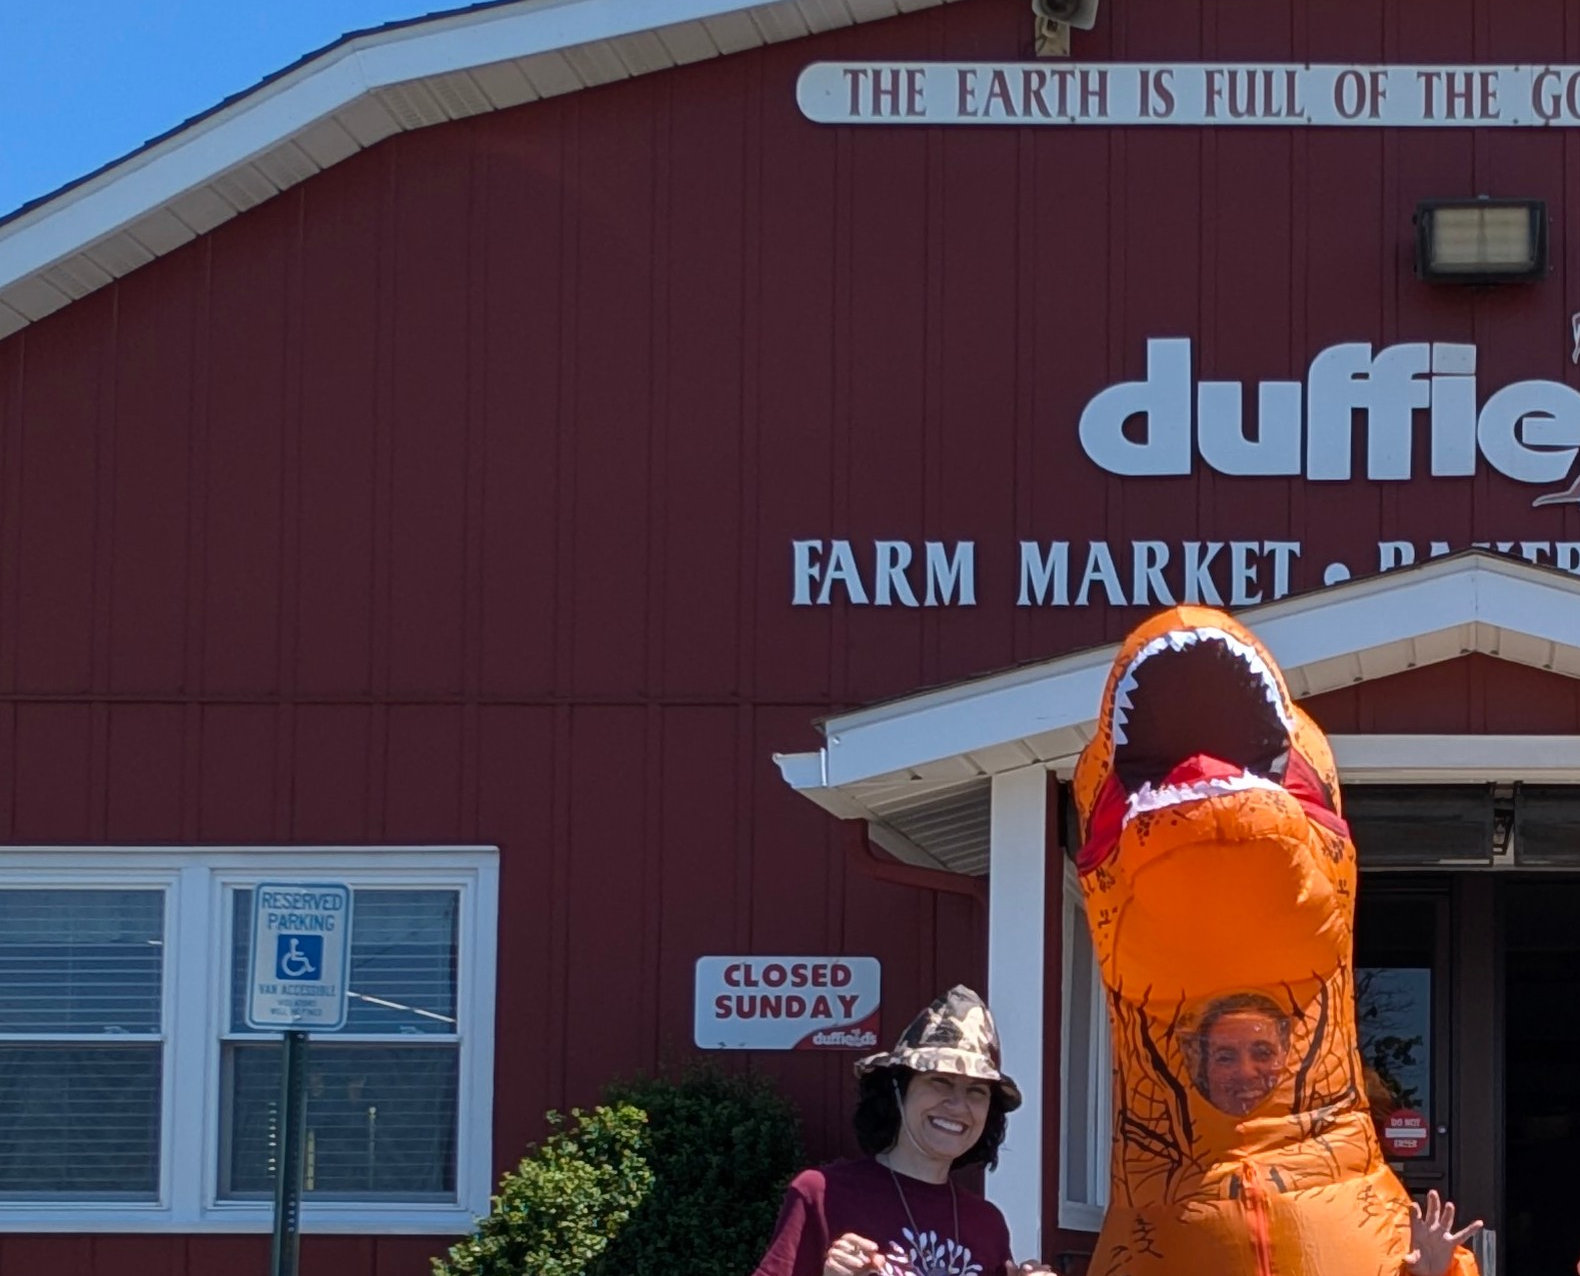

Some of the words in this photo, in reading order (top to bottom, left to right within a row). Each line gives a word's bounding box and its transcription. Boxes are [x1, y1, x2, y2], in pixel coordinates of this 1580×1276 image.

[844, 68, 926, 118] THE
[957, 68, 1109, 118] EARTH
[1138, 69, 1175, 118] IS
[1204, 69, 1305, 118] FULL
[1333, 70, 1388, 118] OF
[1417, 70, 1501, 119] THE
[792, 540, 977, 606] FARM
[1017, 541, 1301, 607] MARKET
[262, 892, 343, 911] RESERVED
[268, 913, 335, 931] PARKING
[724, 963, 852, 987] CLOSED
[715, 994, 860, 1019] SUNDAY
[1391, 1118, 1403, 1127] DO
[1404, 1118, 1421, 1127] NOT
